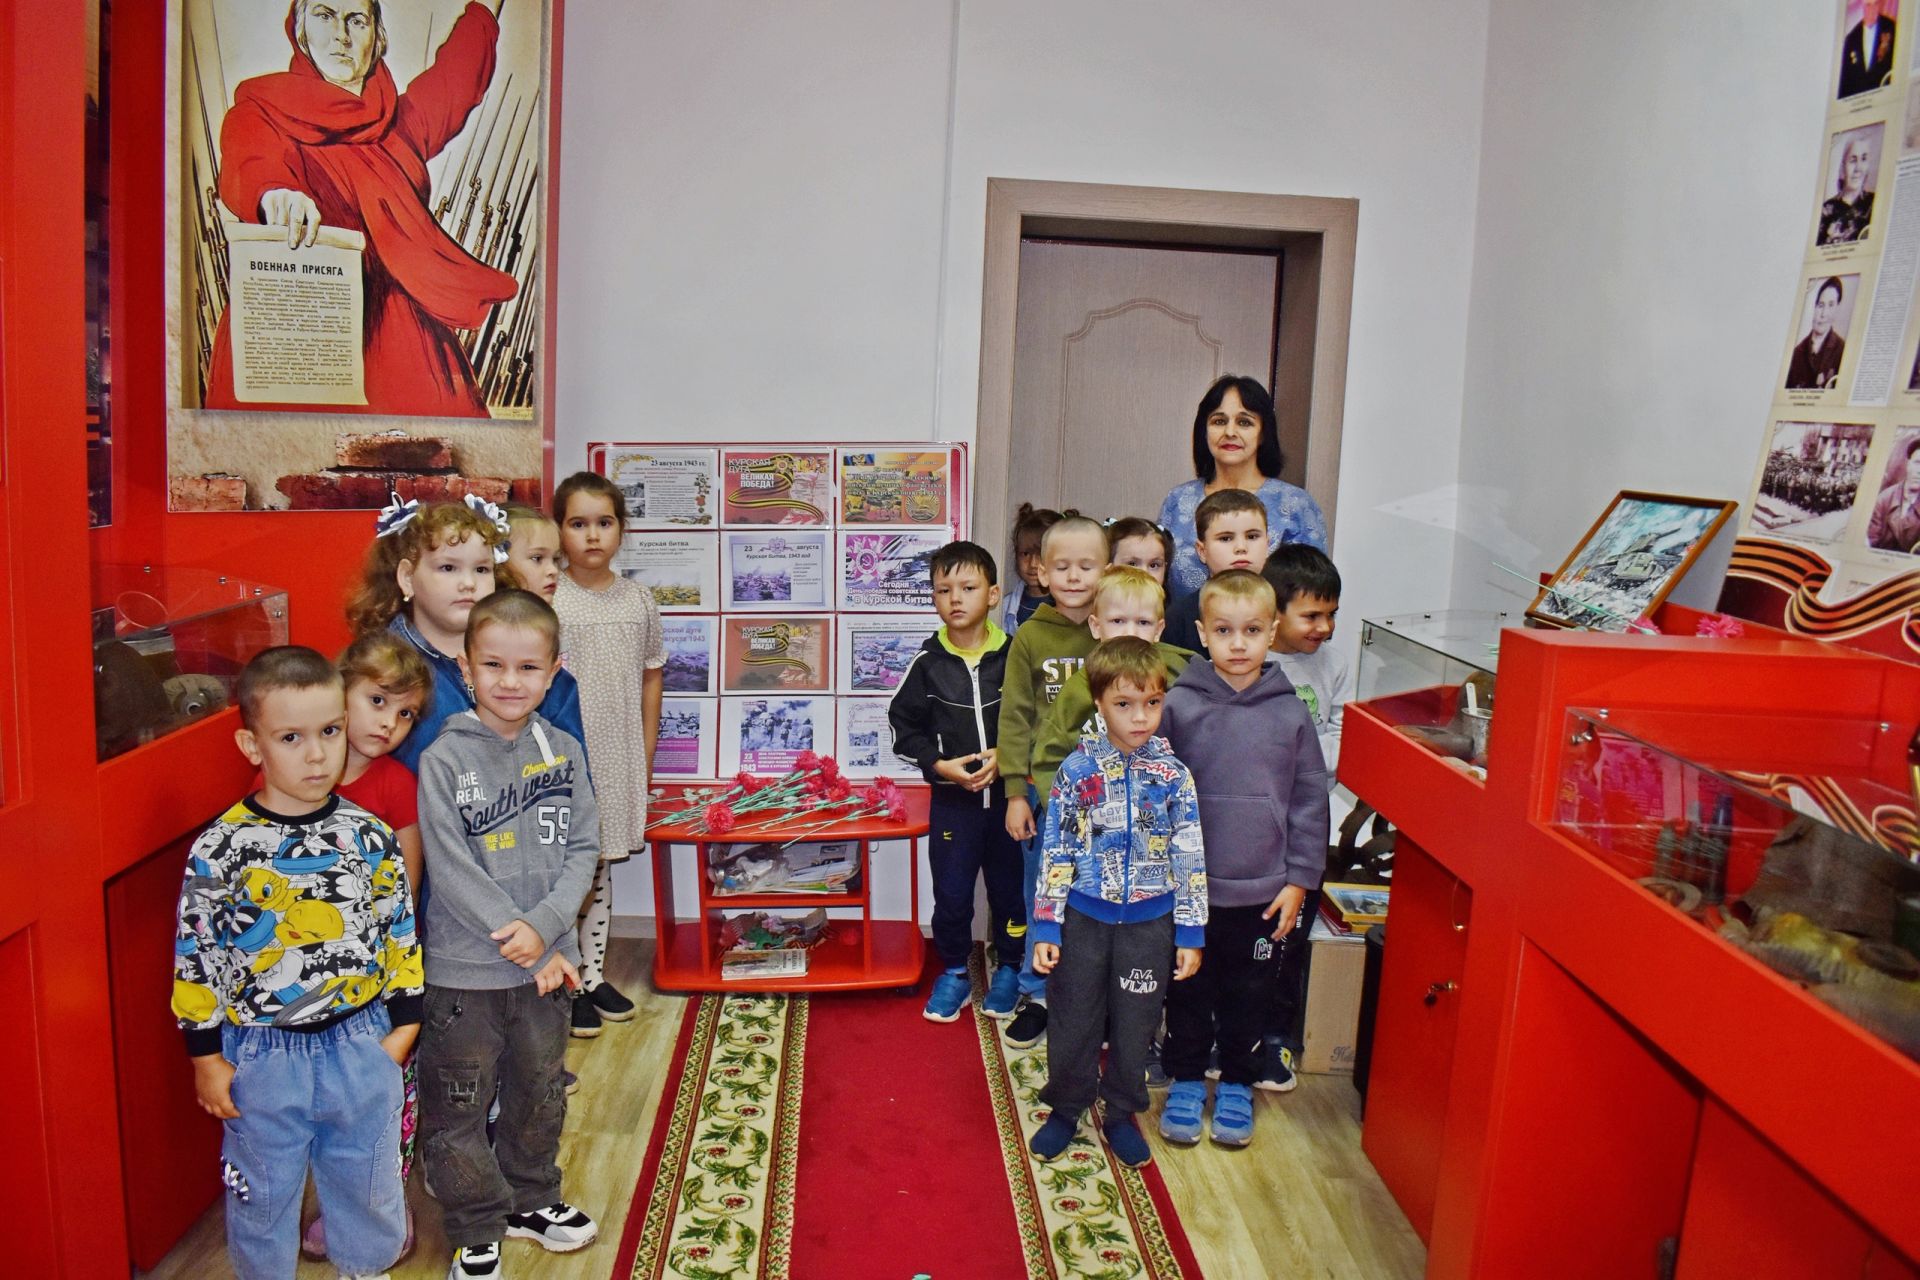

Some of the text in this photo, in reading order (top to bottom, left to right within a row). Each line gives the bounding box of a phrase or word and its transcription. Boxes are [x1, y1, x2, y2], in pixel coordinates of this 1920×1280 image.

[250, 260, 344, 276] ВОЕННАЯ ПРИСЯГА
[740, 480, 774, 488] ПОБЕДА!
[878, 581, 909, 589] Сегодня
[862, 595, 902, 605] Курской
[458, 771, 479, 788] THE
[456, 787, 487, 804] REAL
[459, 760, 575, 836] South west
[537, 804, 571, 846] 59
[1119, 976, 1158, 994] VLAD
